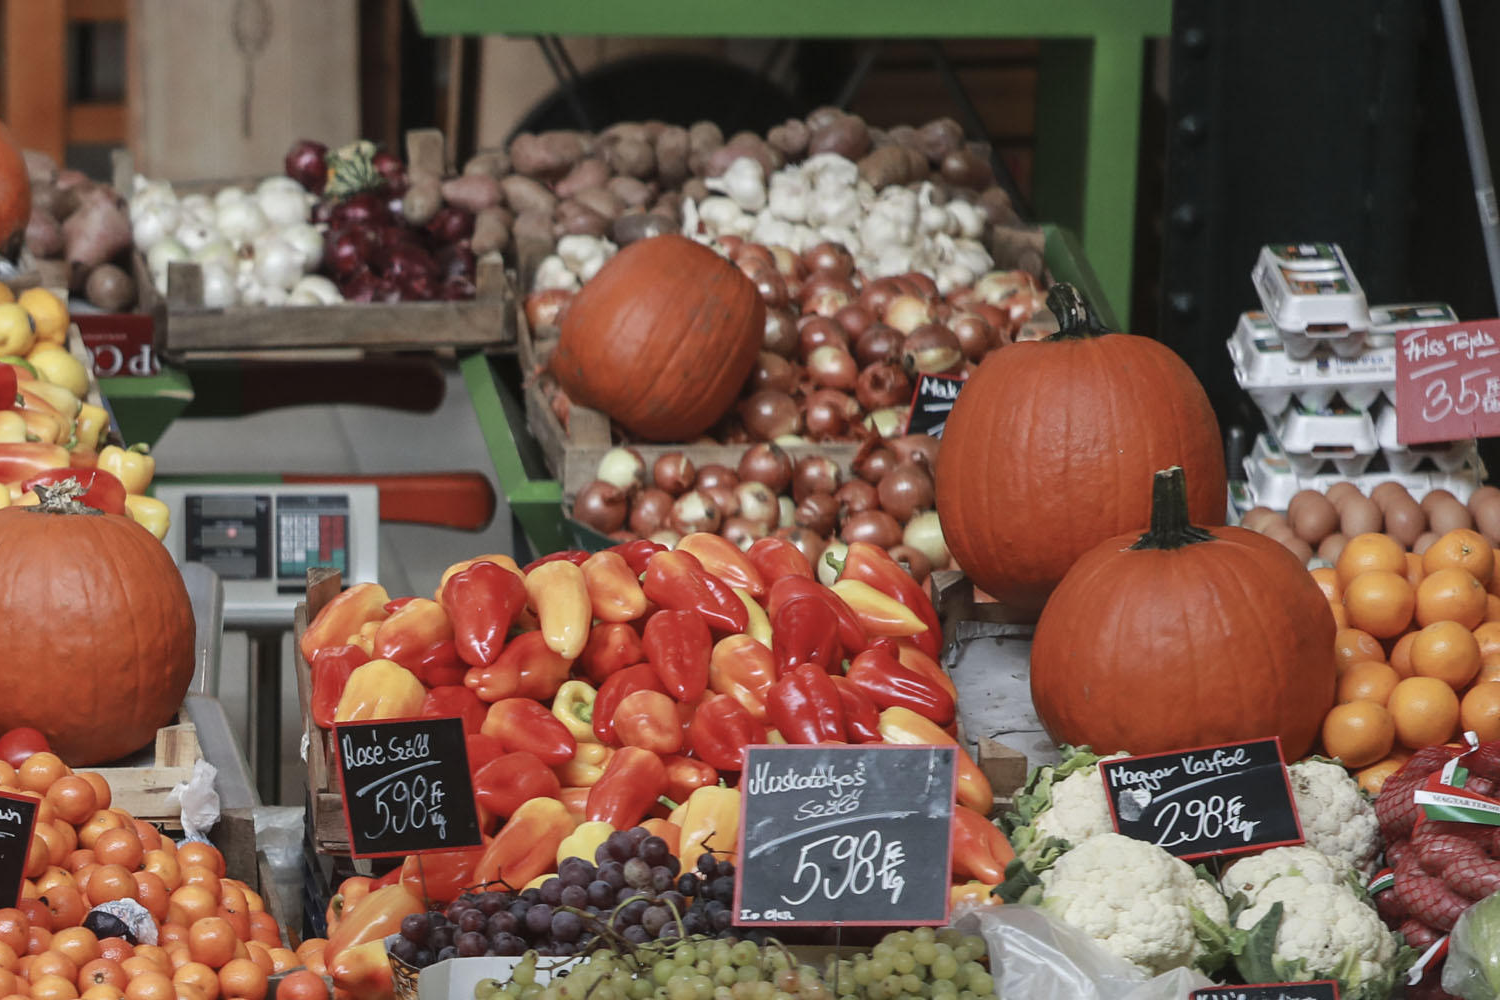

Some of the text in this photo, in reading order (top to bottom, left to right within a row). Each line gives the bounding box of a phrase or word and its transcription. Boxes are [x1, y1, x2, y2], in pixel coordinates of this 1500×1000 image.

[1422, 367, 1492, 423] 35
[1110, 748, 1252, 791] Magyar Karfiol
[364, 774, 428, 840] 598
[1153, 795, 1224, 847] 298
[780, 830, 882, 905] 598
